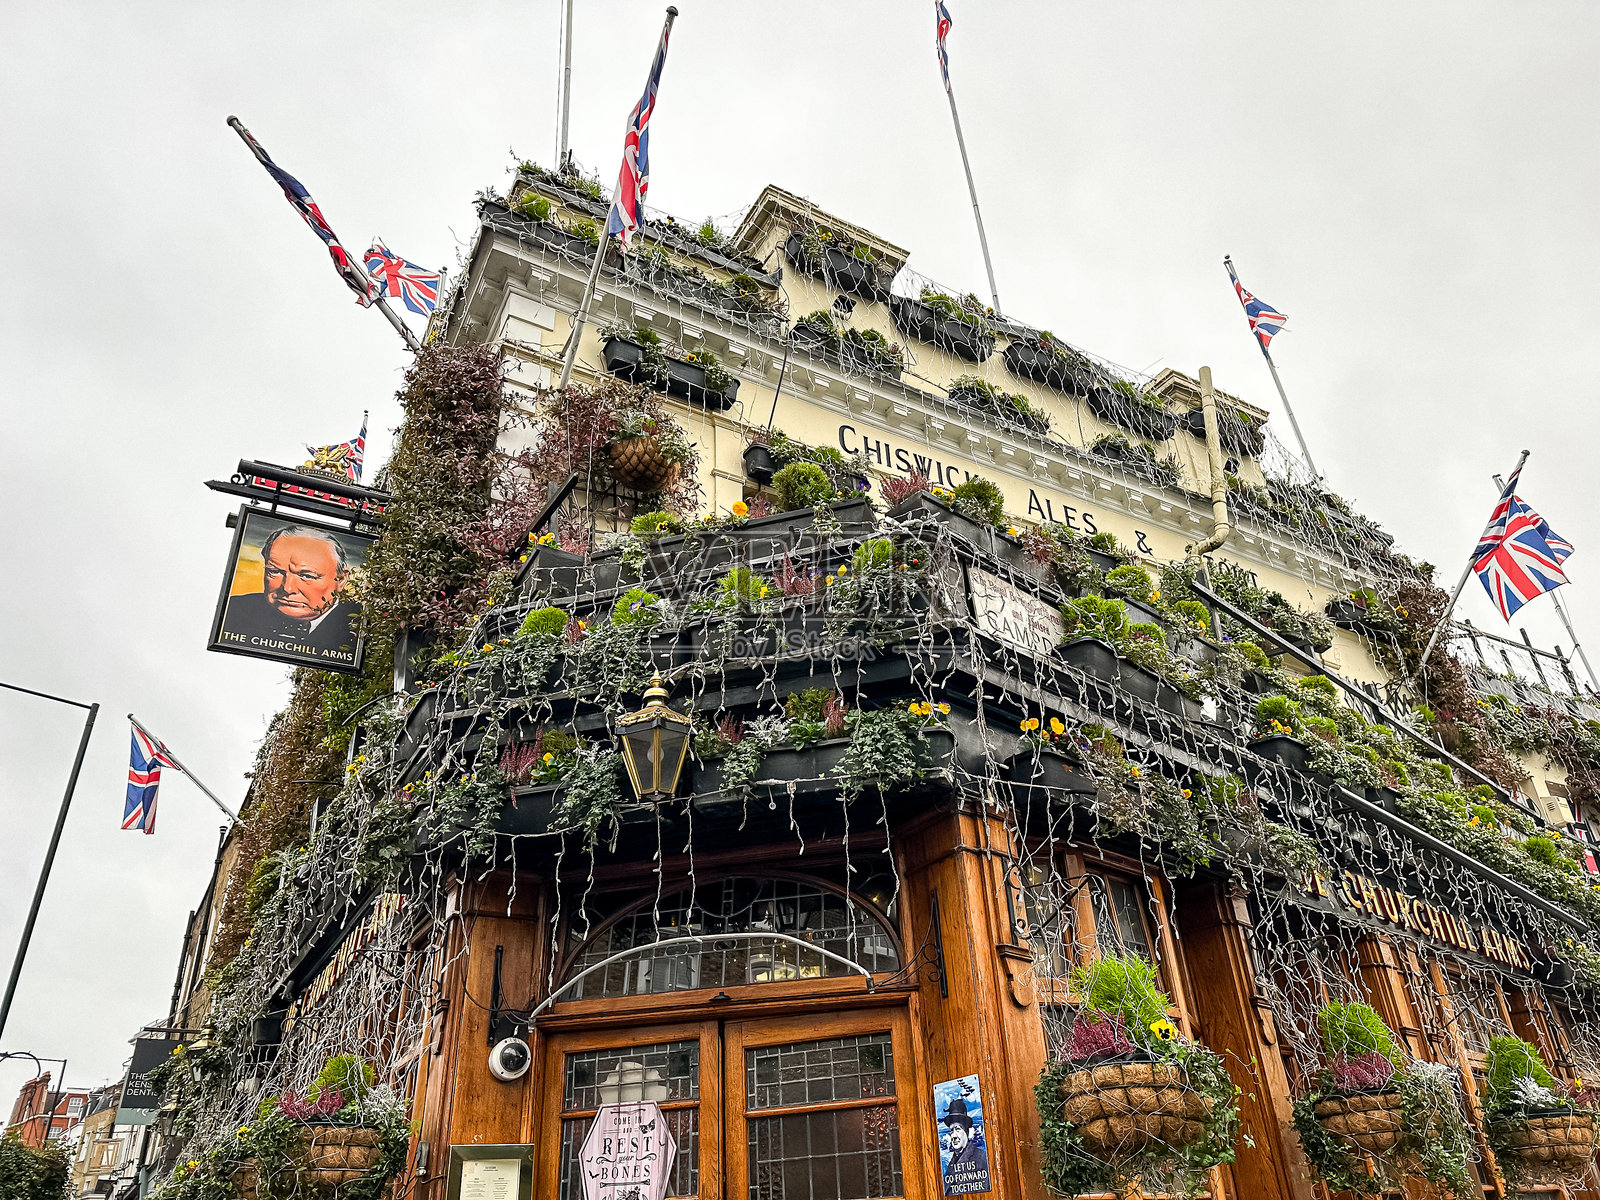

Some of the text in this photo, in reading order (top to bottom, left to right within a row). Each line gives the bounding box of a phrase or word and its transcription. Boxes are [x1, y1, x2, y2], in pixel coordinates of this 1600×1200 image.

[1028, 488, 1098, 536] ALES
[1134, 529, 1153, 557] &
[223, 631, 353, 661] THE CHURCHILL ARMS
[1341, 870, 1477, 952] CHURCHILL
[1480, 925, 1530, 971] ARMS
[613, 1116, 631, 1125] COME
[602, 1136, 653, 1155] REST
[617, 1155, 635, 1164] your
[966, 1161, 976, 1170] US
[600, 1164, 651, 1180] BONES
[945, 1169, 988, 1183] GO FORWARD
